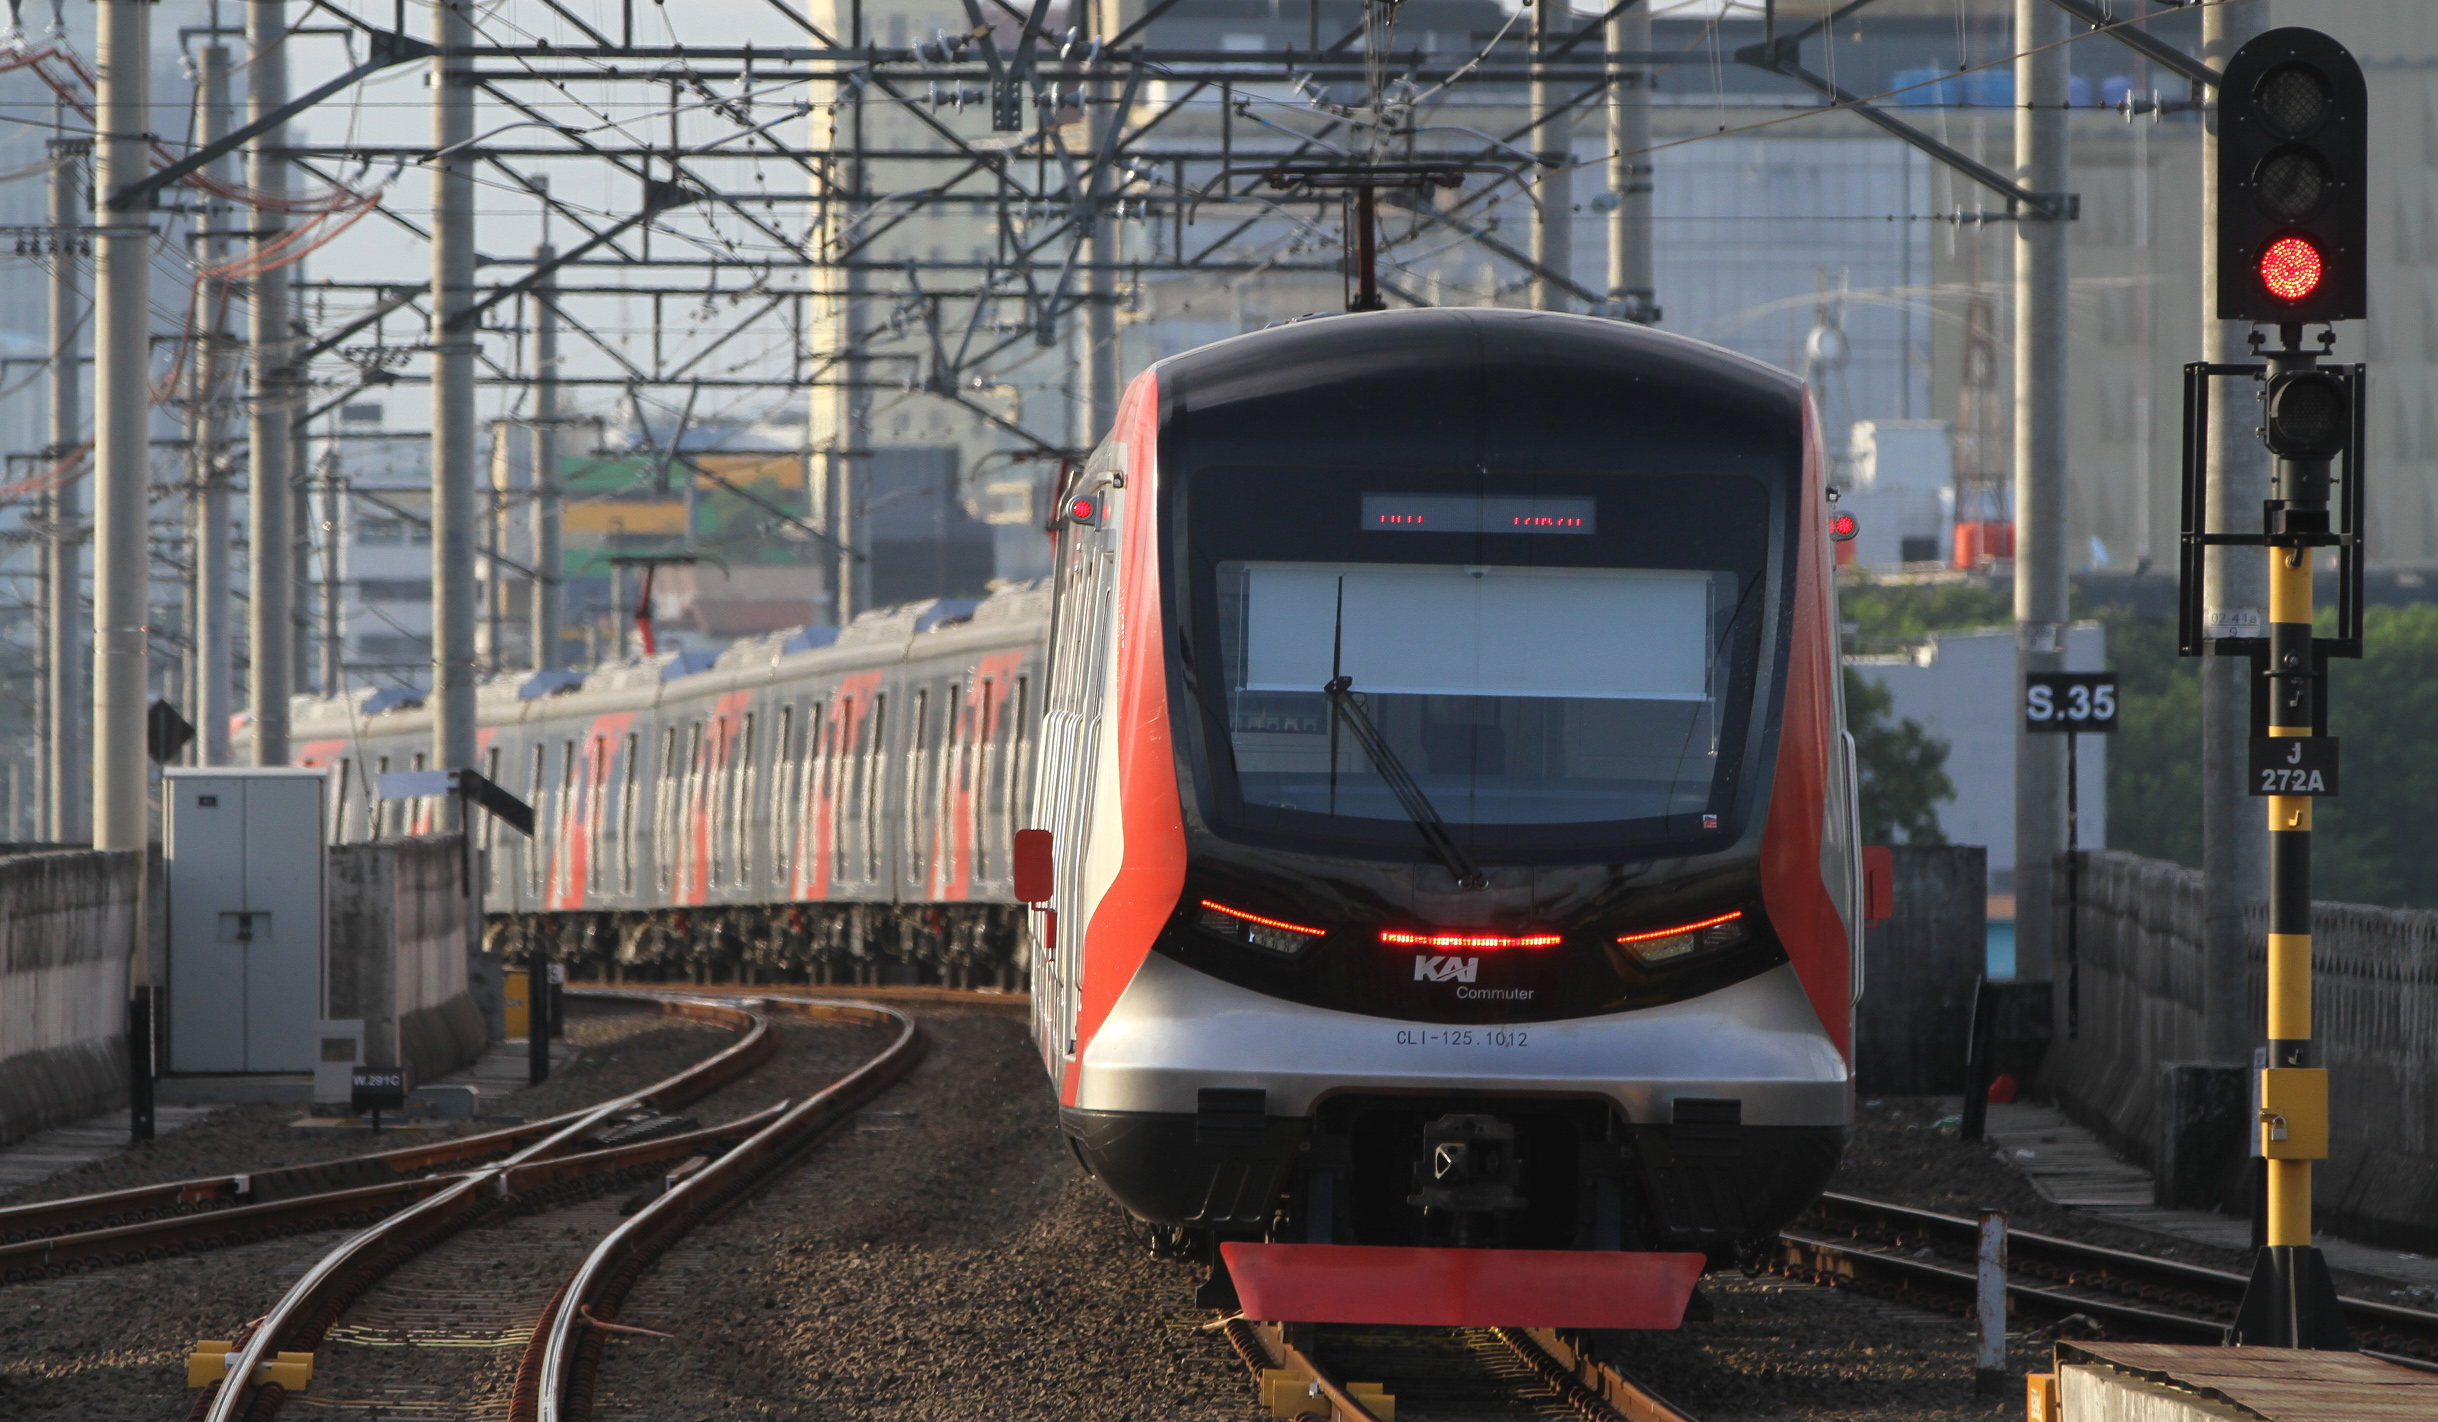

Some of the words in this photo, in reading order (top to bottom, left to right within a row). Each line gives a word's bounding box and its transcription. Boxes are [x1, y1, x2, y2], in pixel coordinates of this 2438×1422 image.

[2028, 684, 2115, 721] S.35
[2286, 742, 2302, 765] J
[2261, 768, 2326, 792] 272A
[1413, 954, 1479, 983] KAI
[1456, 985, 1534, 1000] Commuter
